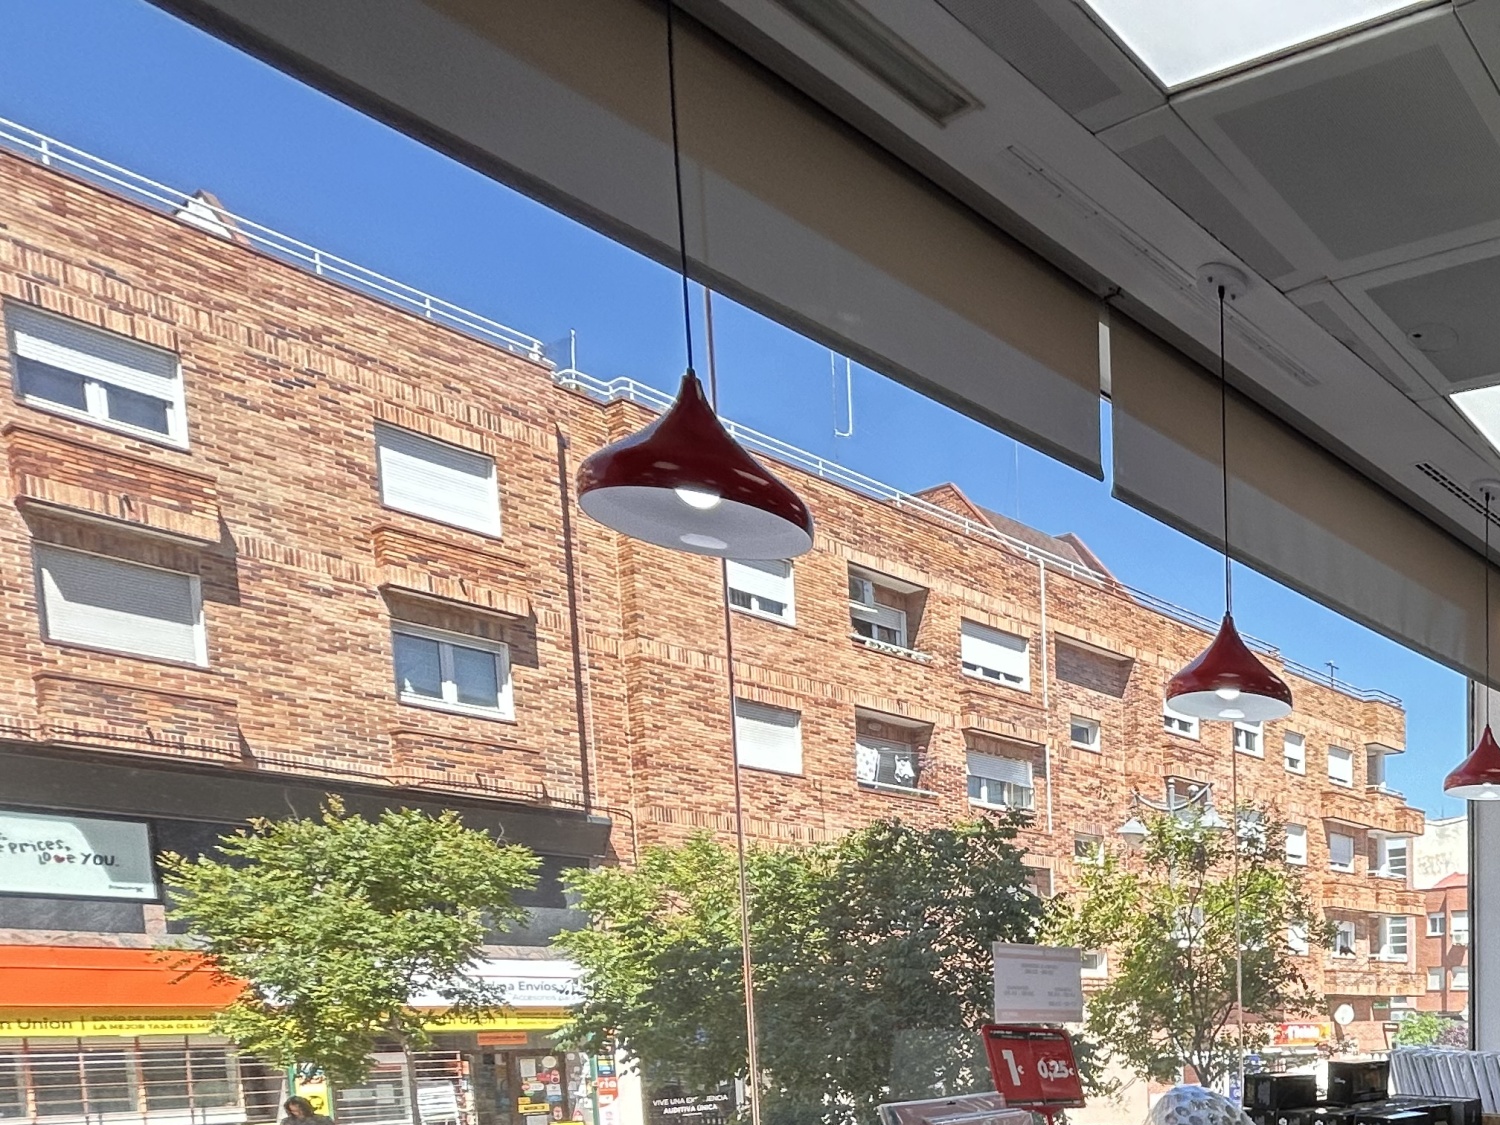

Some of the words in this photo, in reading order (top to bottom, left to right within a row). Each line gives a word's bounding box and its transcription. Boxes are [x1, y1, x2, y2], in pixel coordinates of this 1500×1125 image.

[8, 839, 71, 853] prices,
[518, 981, 557, 991] Envíos
[18, 1017, 73, 1030] Union
[652, 1098, 670, 1107] VIVE
[663, 1104, 696, 1115] AUDITIVA
